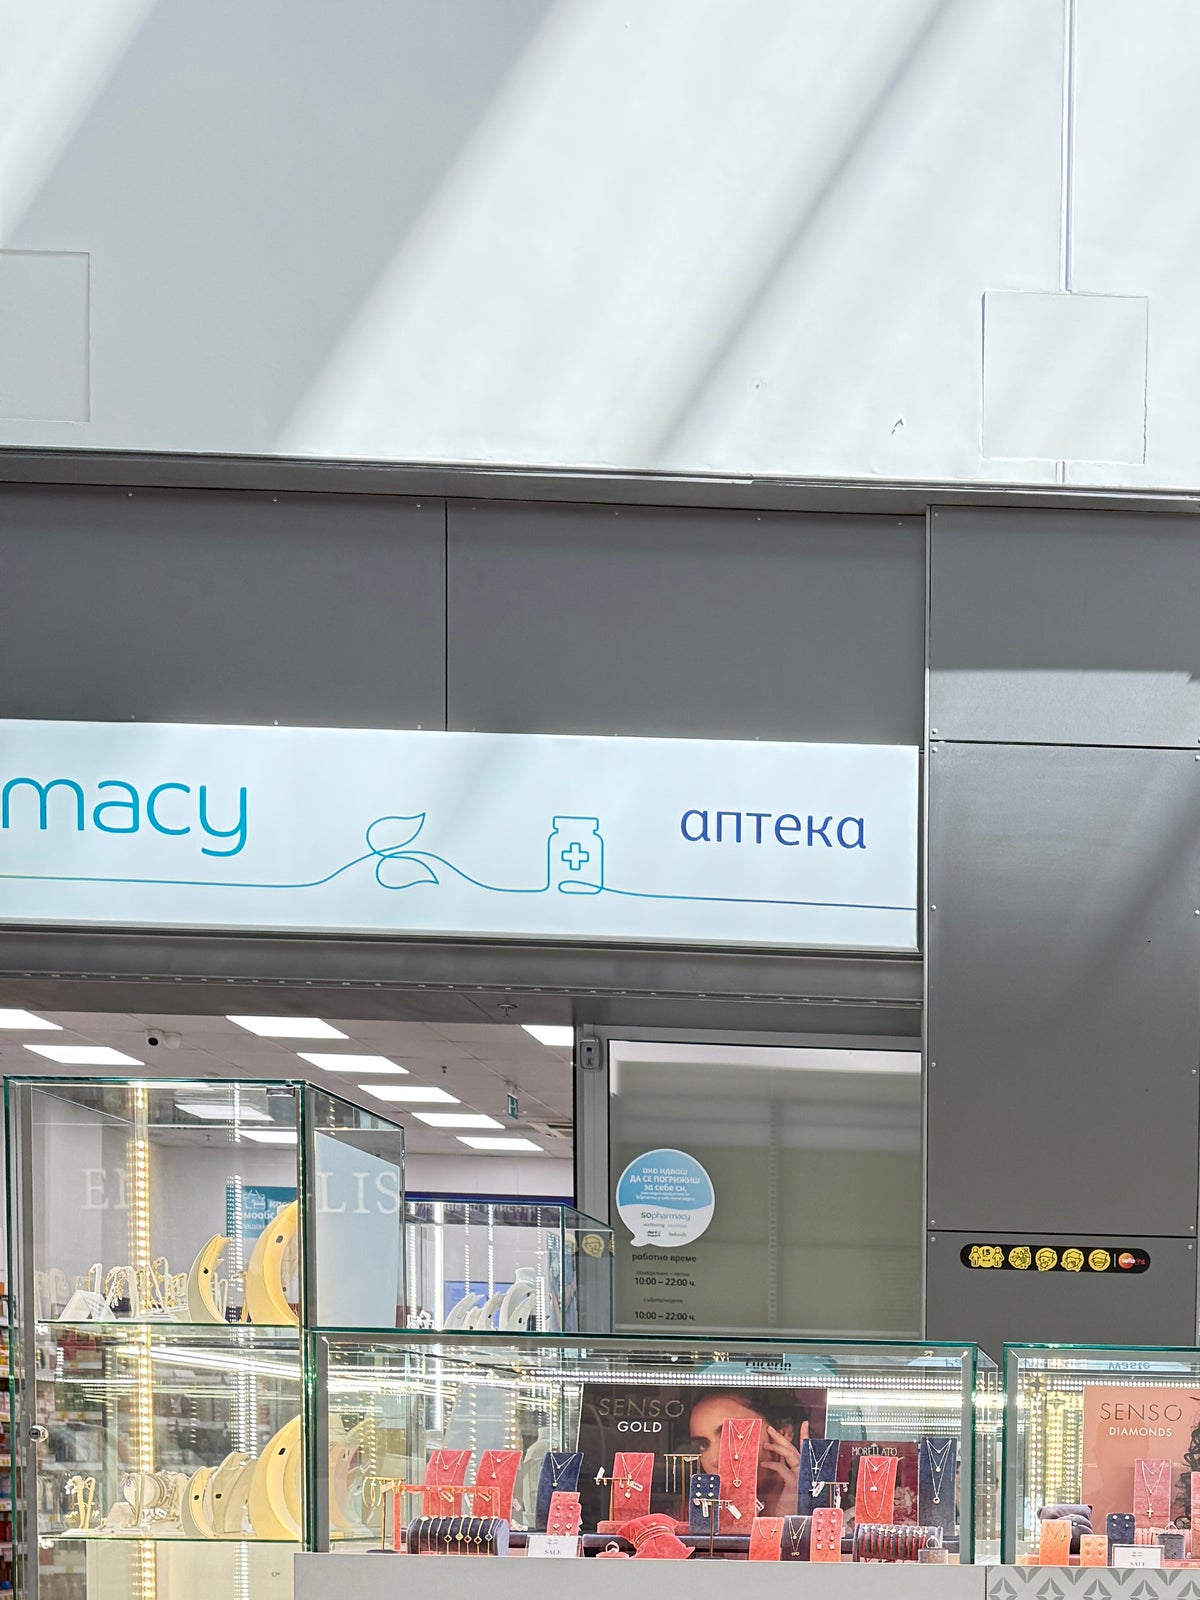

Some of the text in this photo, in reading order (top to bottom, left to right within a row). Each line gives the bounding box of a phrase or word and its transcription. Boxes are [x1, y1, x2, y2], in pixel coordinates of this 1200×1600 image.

[0, 775, 248, 858] macy
[680, 803, 867, 850] аптека
[629, 1175, 700, 1185] ДА СЕ ПОГРИЖИШ
[655, 1184, 674, 1192] себе
[632, 1253, 697, 1264] работно време
[634, 1277, 656, 1286] 10:00
[665, 1278, 688, 1287] 22:00
[634, 1311, 656, 1320] 10:00
[665, 1312, 688, 1321] 22:00
[598, 1397, 684, 1418] SENSO
[1099, 1401, 1183, 1422] SENSO
[617, 1420, 662, 1434] GOLD
[1108, 1426, 1173, 1438] DIAMONDS
[851, 1446, 898, 1457] MORELLATO
